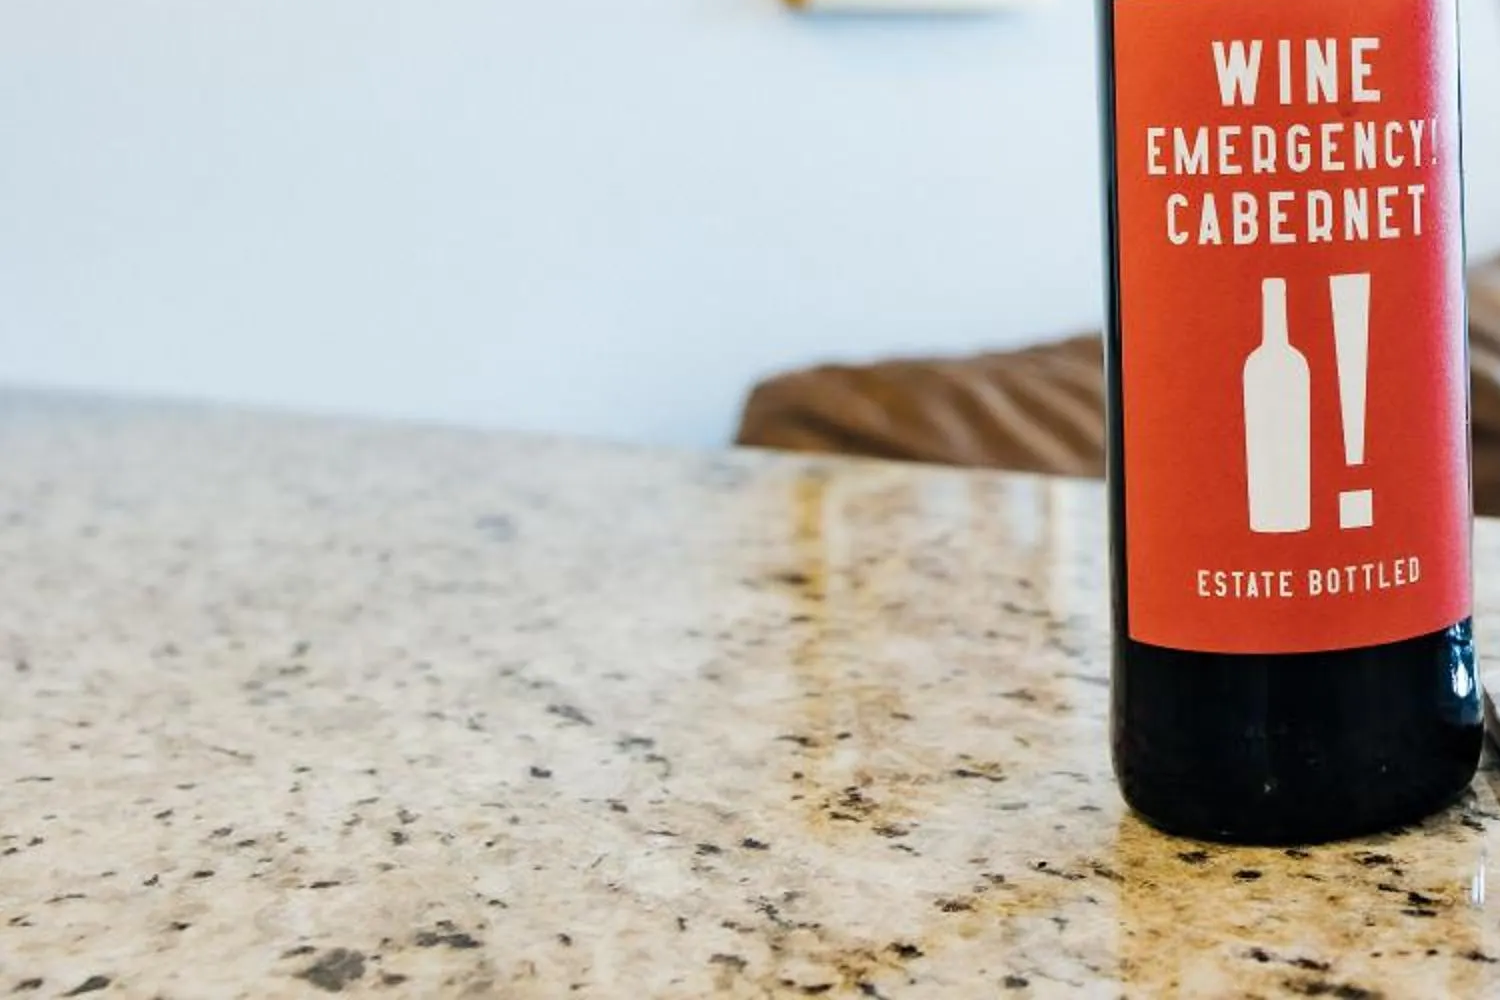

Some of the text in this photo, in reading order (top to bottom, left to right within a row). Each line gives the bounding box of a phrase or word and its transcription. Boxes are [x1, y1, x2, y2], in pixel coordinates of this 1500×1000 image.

[1211, 37, 1382, 107] WINE
[1146, 118, 1438, 176] EMERGENCY!
[1165, 183, 1426, 246] CABERNET
[1196, 555, 1422, 599] ESTATE BOTTLED
